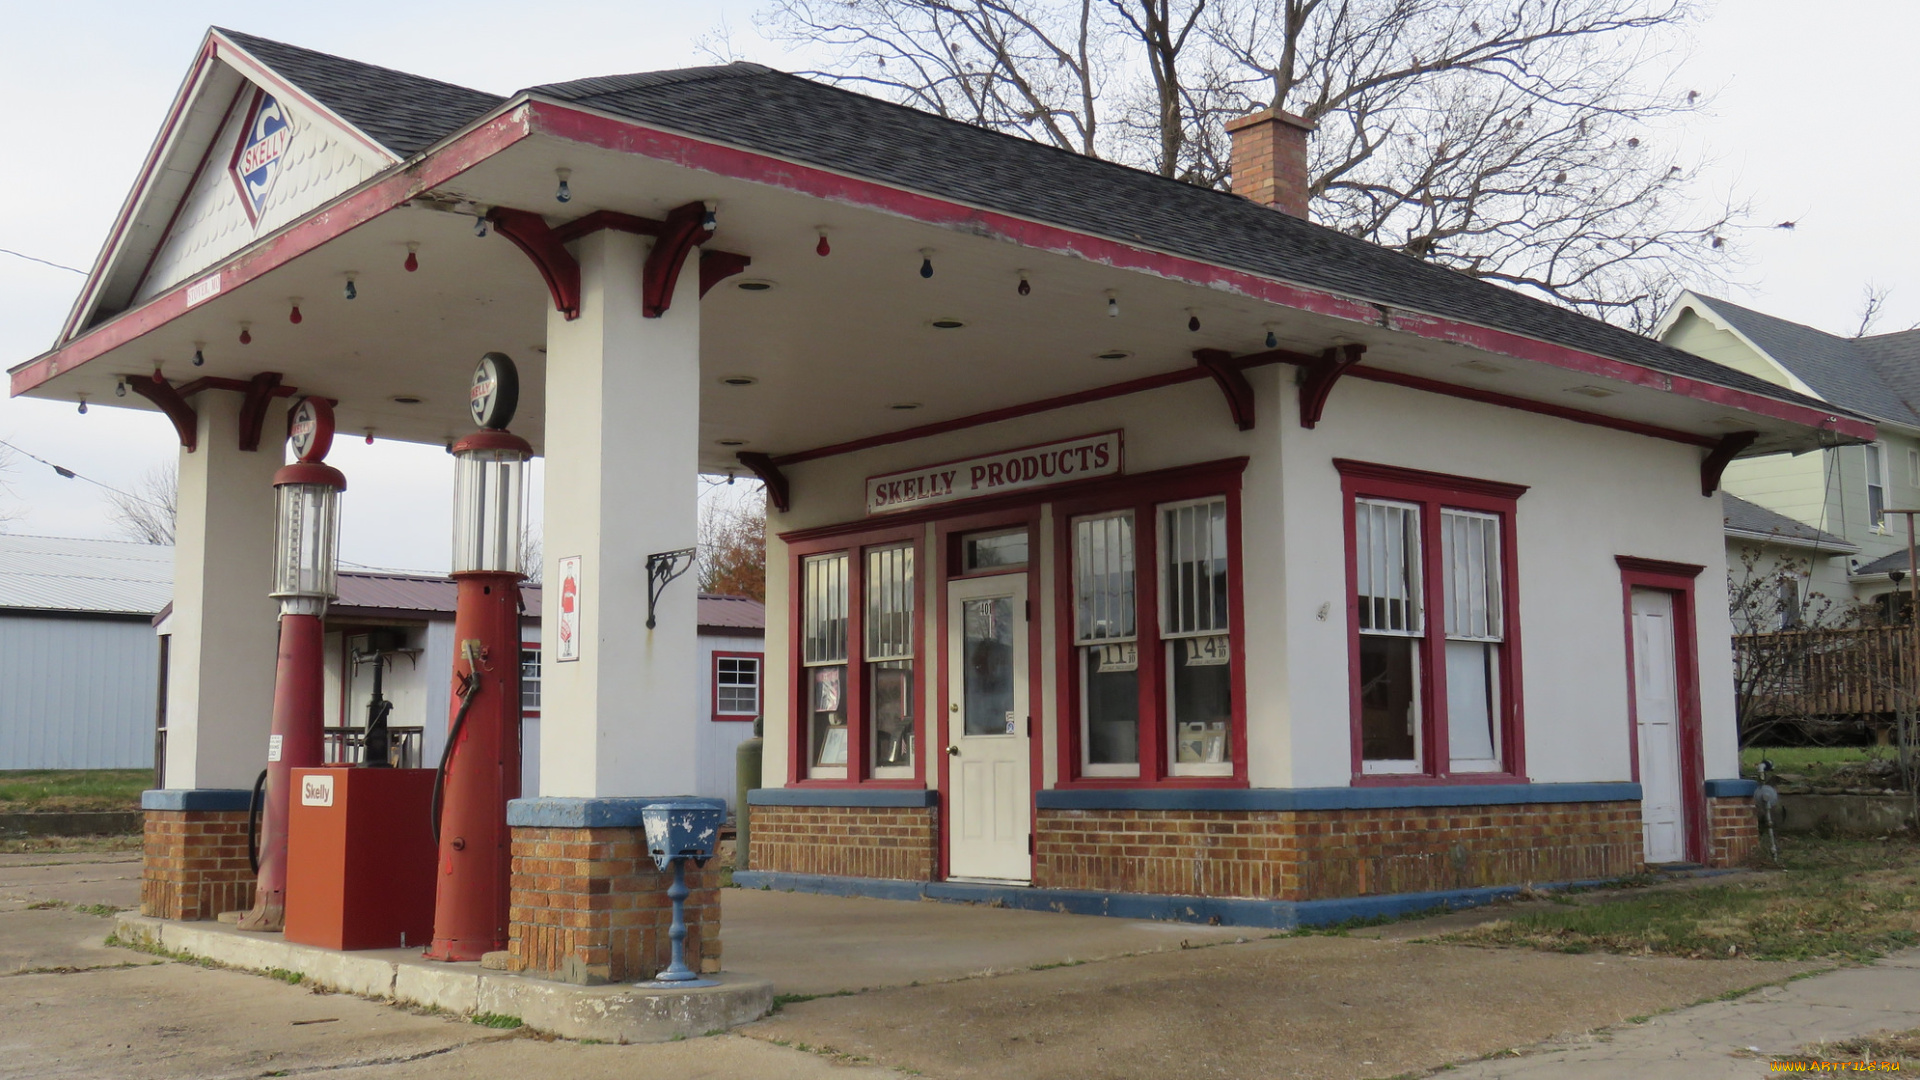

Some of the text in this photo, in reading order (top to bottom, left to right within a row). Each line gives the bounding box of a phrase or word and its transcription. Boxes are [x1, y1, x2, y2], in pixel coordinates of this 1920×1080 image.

[245, 130, 287, 173] SKELLY
[471, 382, 491, 399] KELLY
[292, 421, 314, 435] KELLY
[875, 442, 1110, 507] SKELLY PRODUCTS
[305, 782, 330, 802] Skelly
